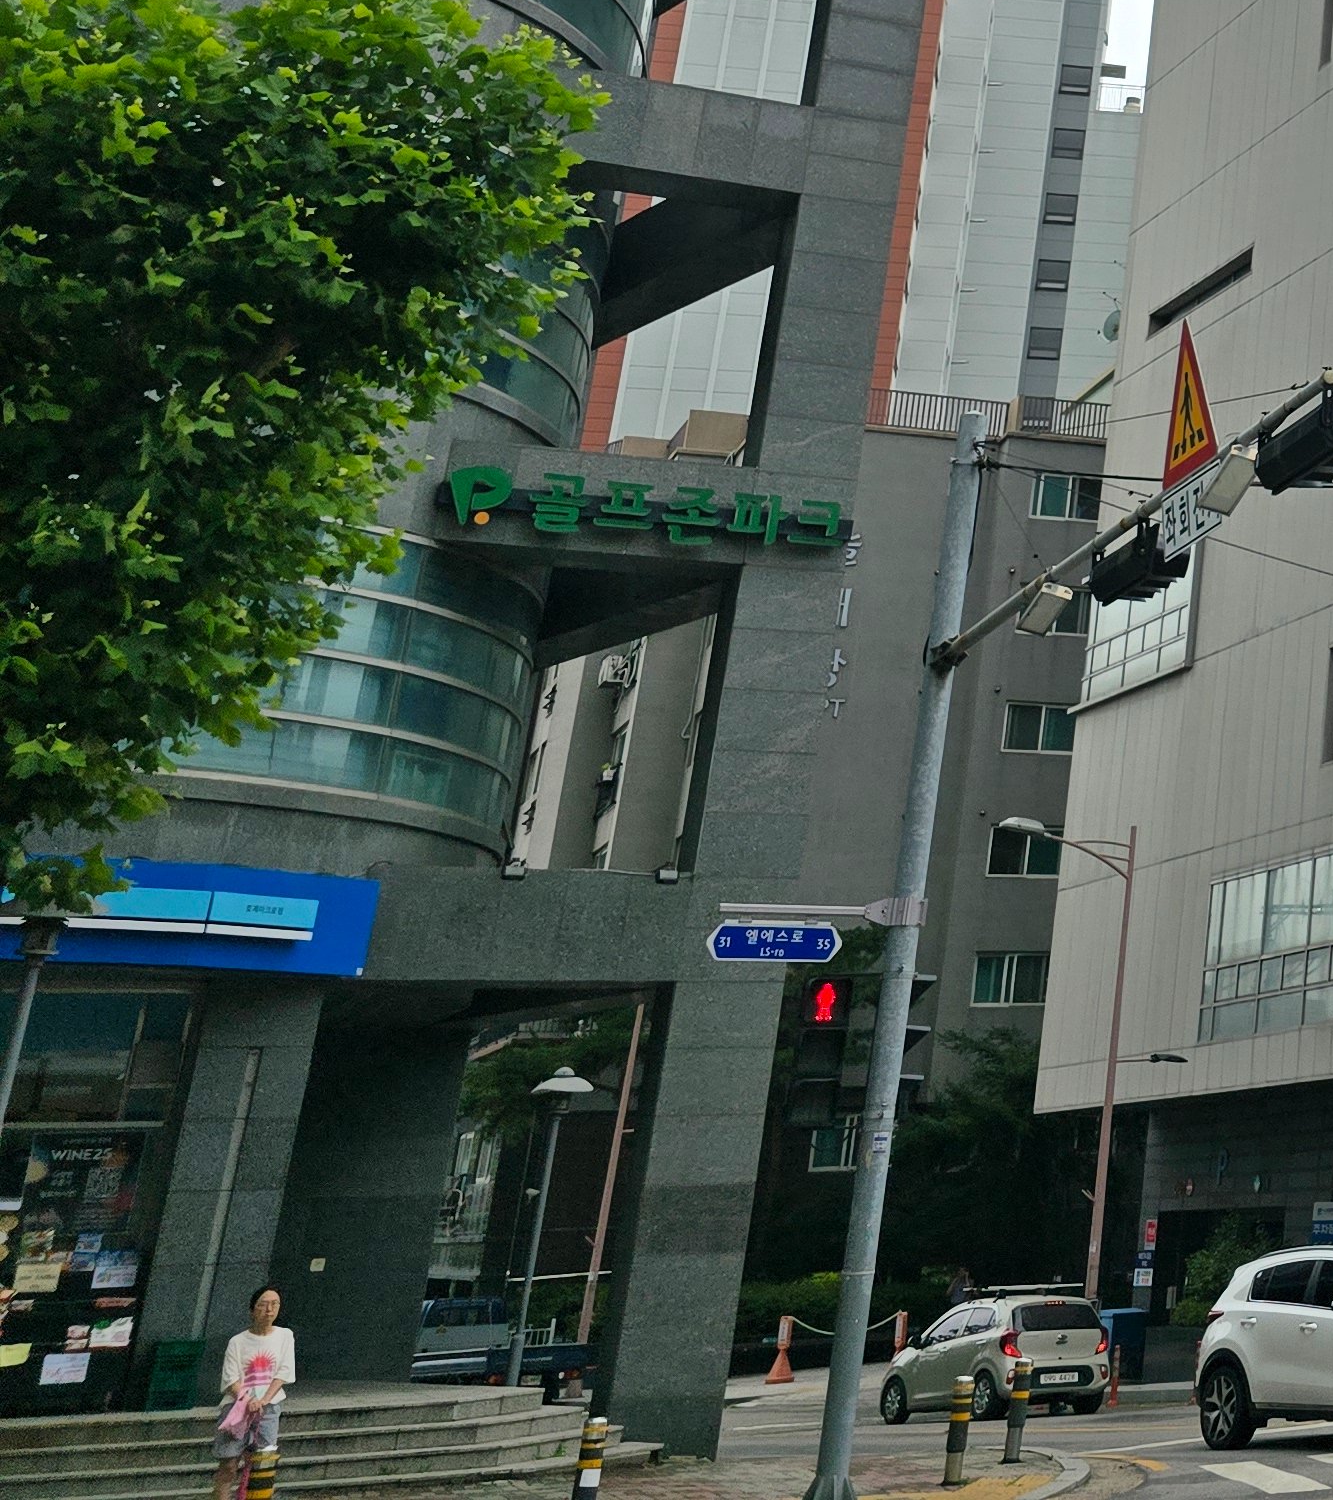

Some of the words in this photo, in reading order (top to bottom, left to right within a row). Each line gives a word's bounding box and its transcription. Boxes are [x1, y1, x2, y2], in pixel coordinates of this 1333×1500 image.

[529, 472, 848, 547] 골프존파크
[1165, 476, 1220, 547] 좌회전
[718, 936, 731, 948] 31
[745, 929, 804, 945] 엘에스로
[816, 938, 831, 950] 35
[759, 947, 785, 957] LS-ro
